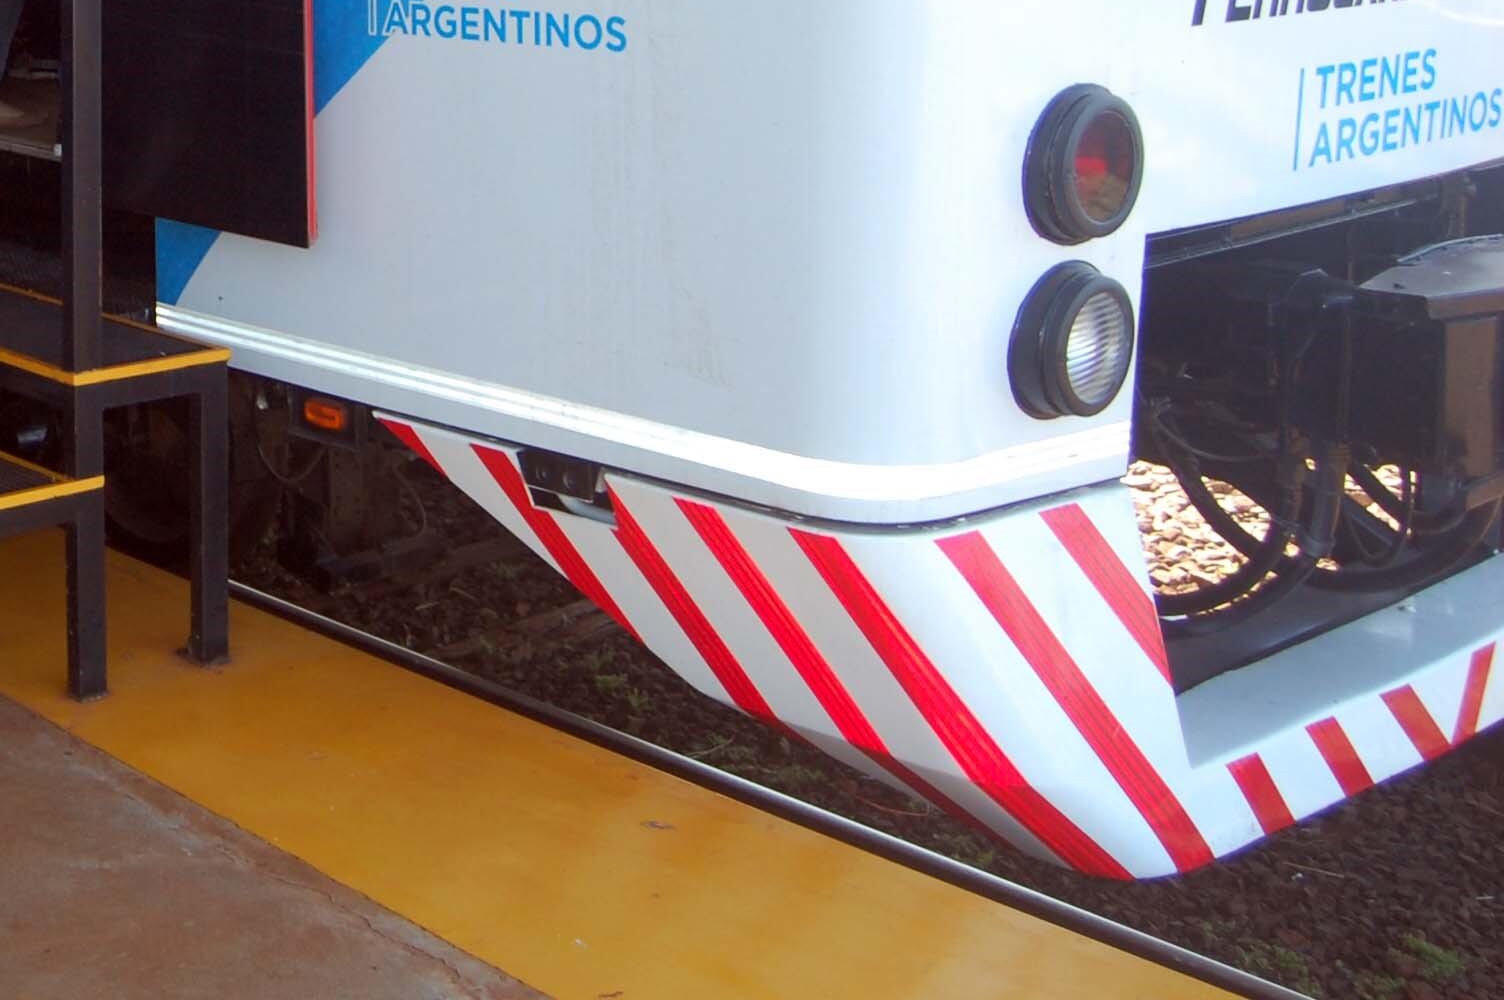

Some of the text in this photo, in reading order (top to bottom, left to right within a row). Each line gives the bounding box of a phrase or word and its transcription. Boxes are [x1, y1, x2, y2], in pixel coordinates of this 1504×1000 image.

[385, 1, 627, 52] ARGENTINOS
[1316, 49, 1437, 108] TRENES
[1309, 88, 1503, 167] ARGENTINOS
